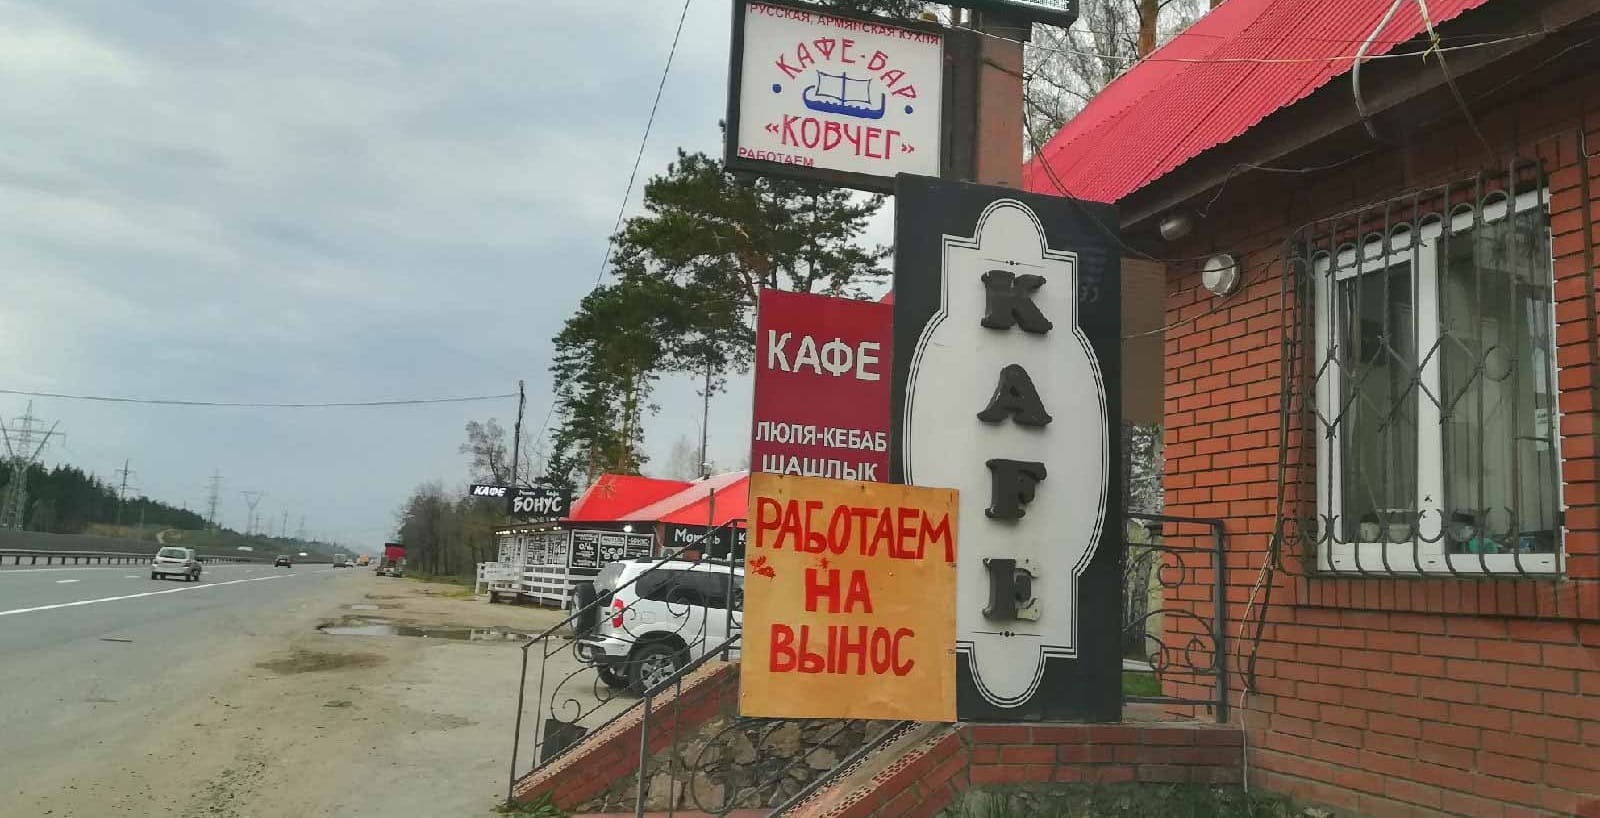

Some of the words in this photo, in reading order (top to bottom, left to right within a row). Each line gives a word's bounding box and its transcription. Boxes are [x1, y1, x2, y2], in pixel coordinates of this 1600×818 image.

[817, 17, 895, 37] АРМЯНСКАЯ
[776, 37, 916, 99] КАФЕ-БАР
[765, 114, 915, 160] «КОВЧЕГ»
[738, 147, 814, 167] РАБОТАЕМ
[768, 330, 881, 381] КАФЕ
[756, 421, 887, 452] ЛЮЛЯ-КЕБАБ
[762, 454, 878, 482] ШАШЛЫК
[474, 485, 506, 497] КАФЕ
[513, 496, 562, 515] БОНУС
[755, 496, 955, 562] РАБОТАЕМ
[805, 568, 873, 614] НА
[769, 623, 915, 677] ВЫНОС
